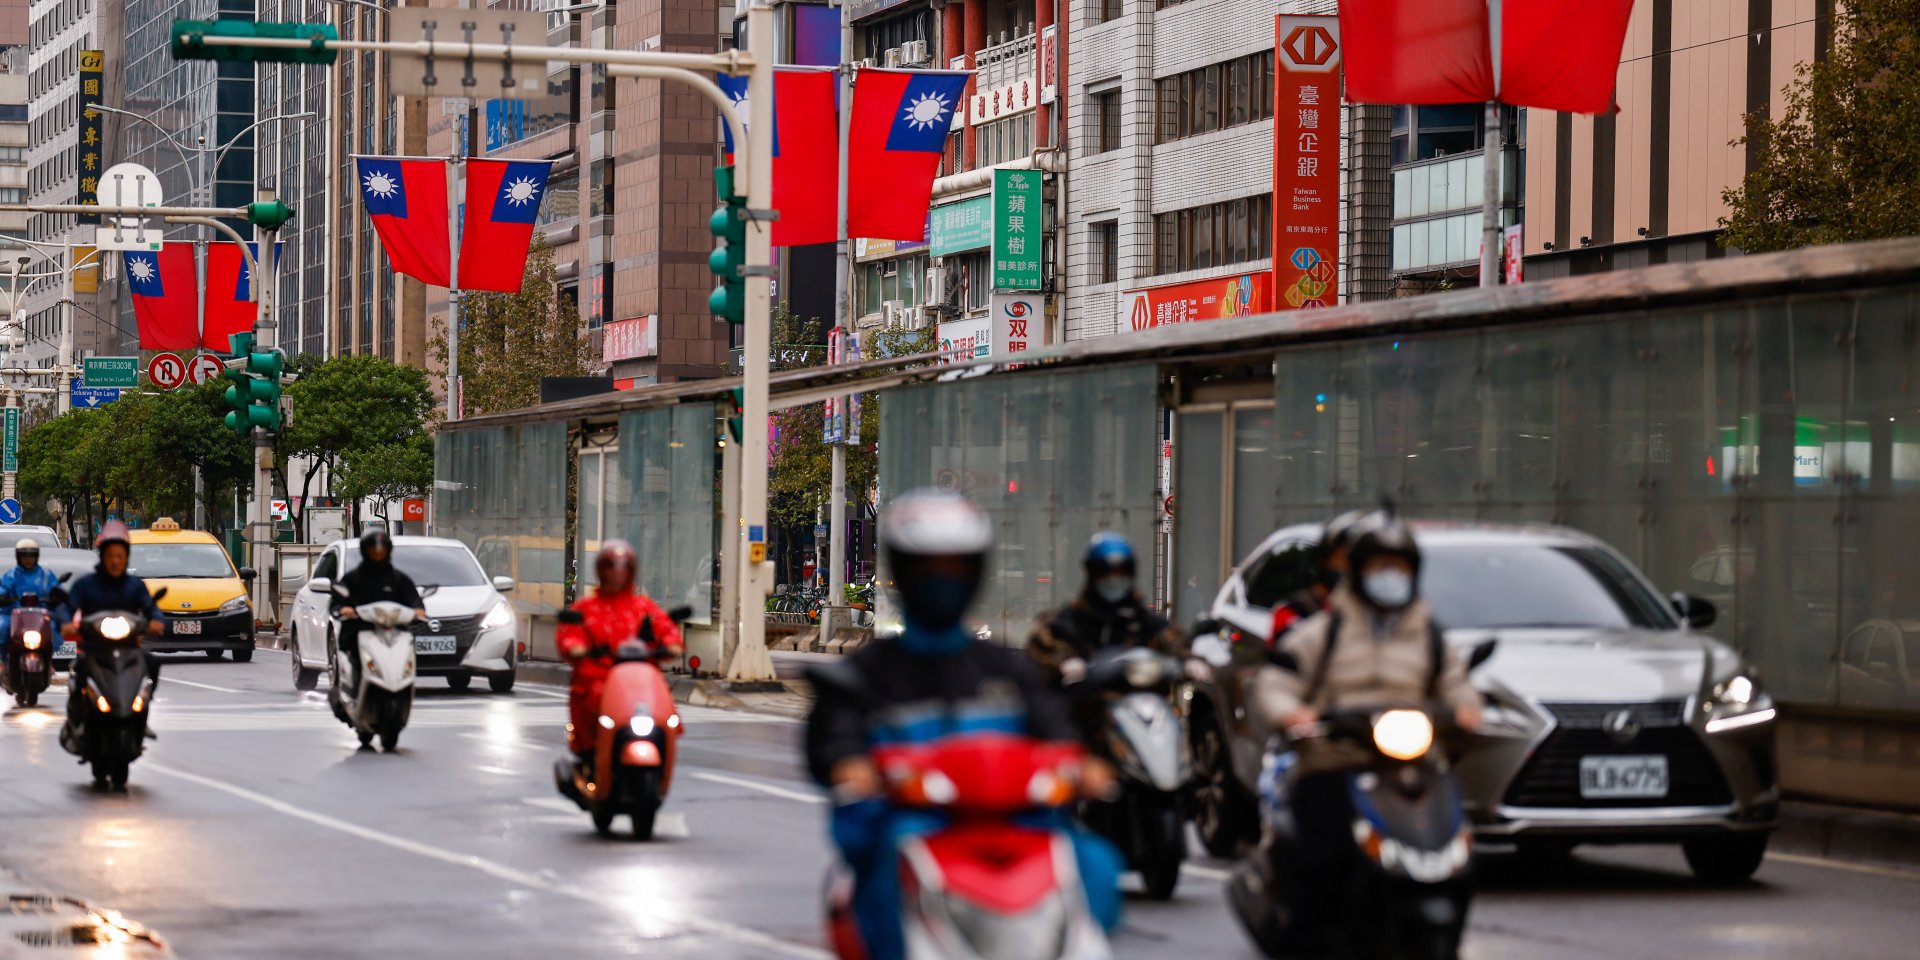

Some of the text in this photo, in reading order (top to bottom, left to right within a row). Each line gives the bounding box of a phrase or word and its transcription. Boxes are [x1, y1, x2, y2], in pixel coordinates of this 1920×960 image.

[1298, 85, 1319, 177] 臺灣企銀
[1293, 188, 1317, 196] Taiwan
[1008, 194, 1026, 255] 蘋果樹
[1285, 225, 1328, 234] 南京東路分行
[997, 260, 1038, 271] 醫美診所
[408, 504, 423, 514] Co
